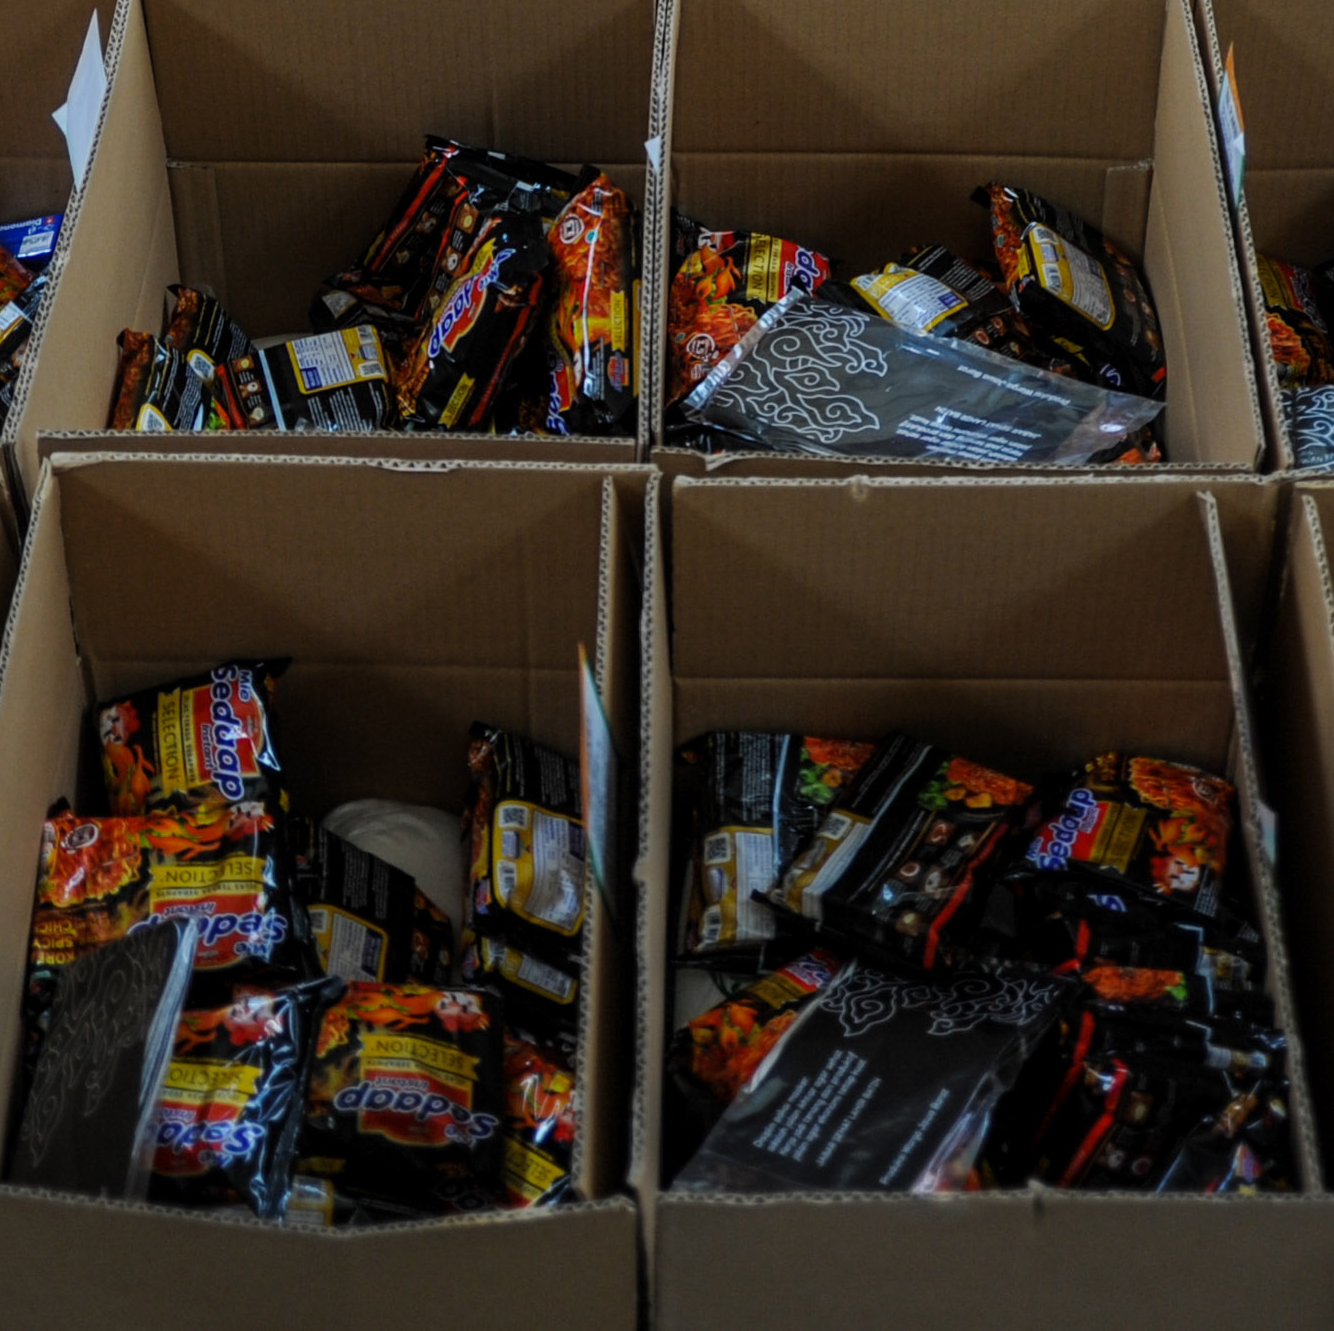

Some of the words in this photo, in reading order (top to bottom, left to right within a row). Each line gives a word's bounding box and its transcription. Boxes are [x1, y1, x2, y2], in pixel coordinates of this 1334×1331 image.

[238, 669, 253, 703] Mie
[161, 700, 180, 781] SELECTION
[200, 722, 214, 771] Instant
[210, 664, 245, 801] Sedaap
[166, 860, 255, 882] SELECTION
[375, 1039, 465, 1069] SELECTION
[373, 1075, 430, 1091] Instant
[334, 1081, 501, 1140] Sedaap
